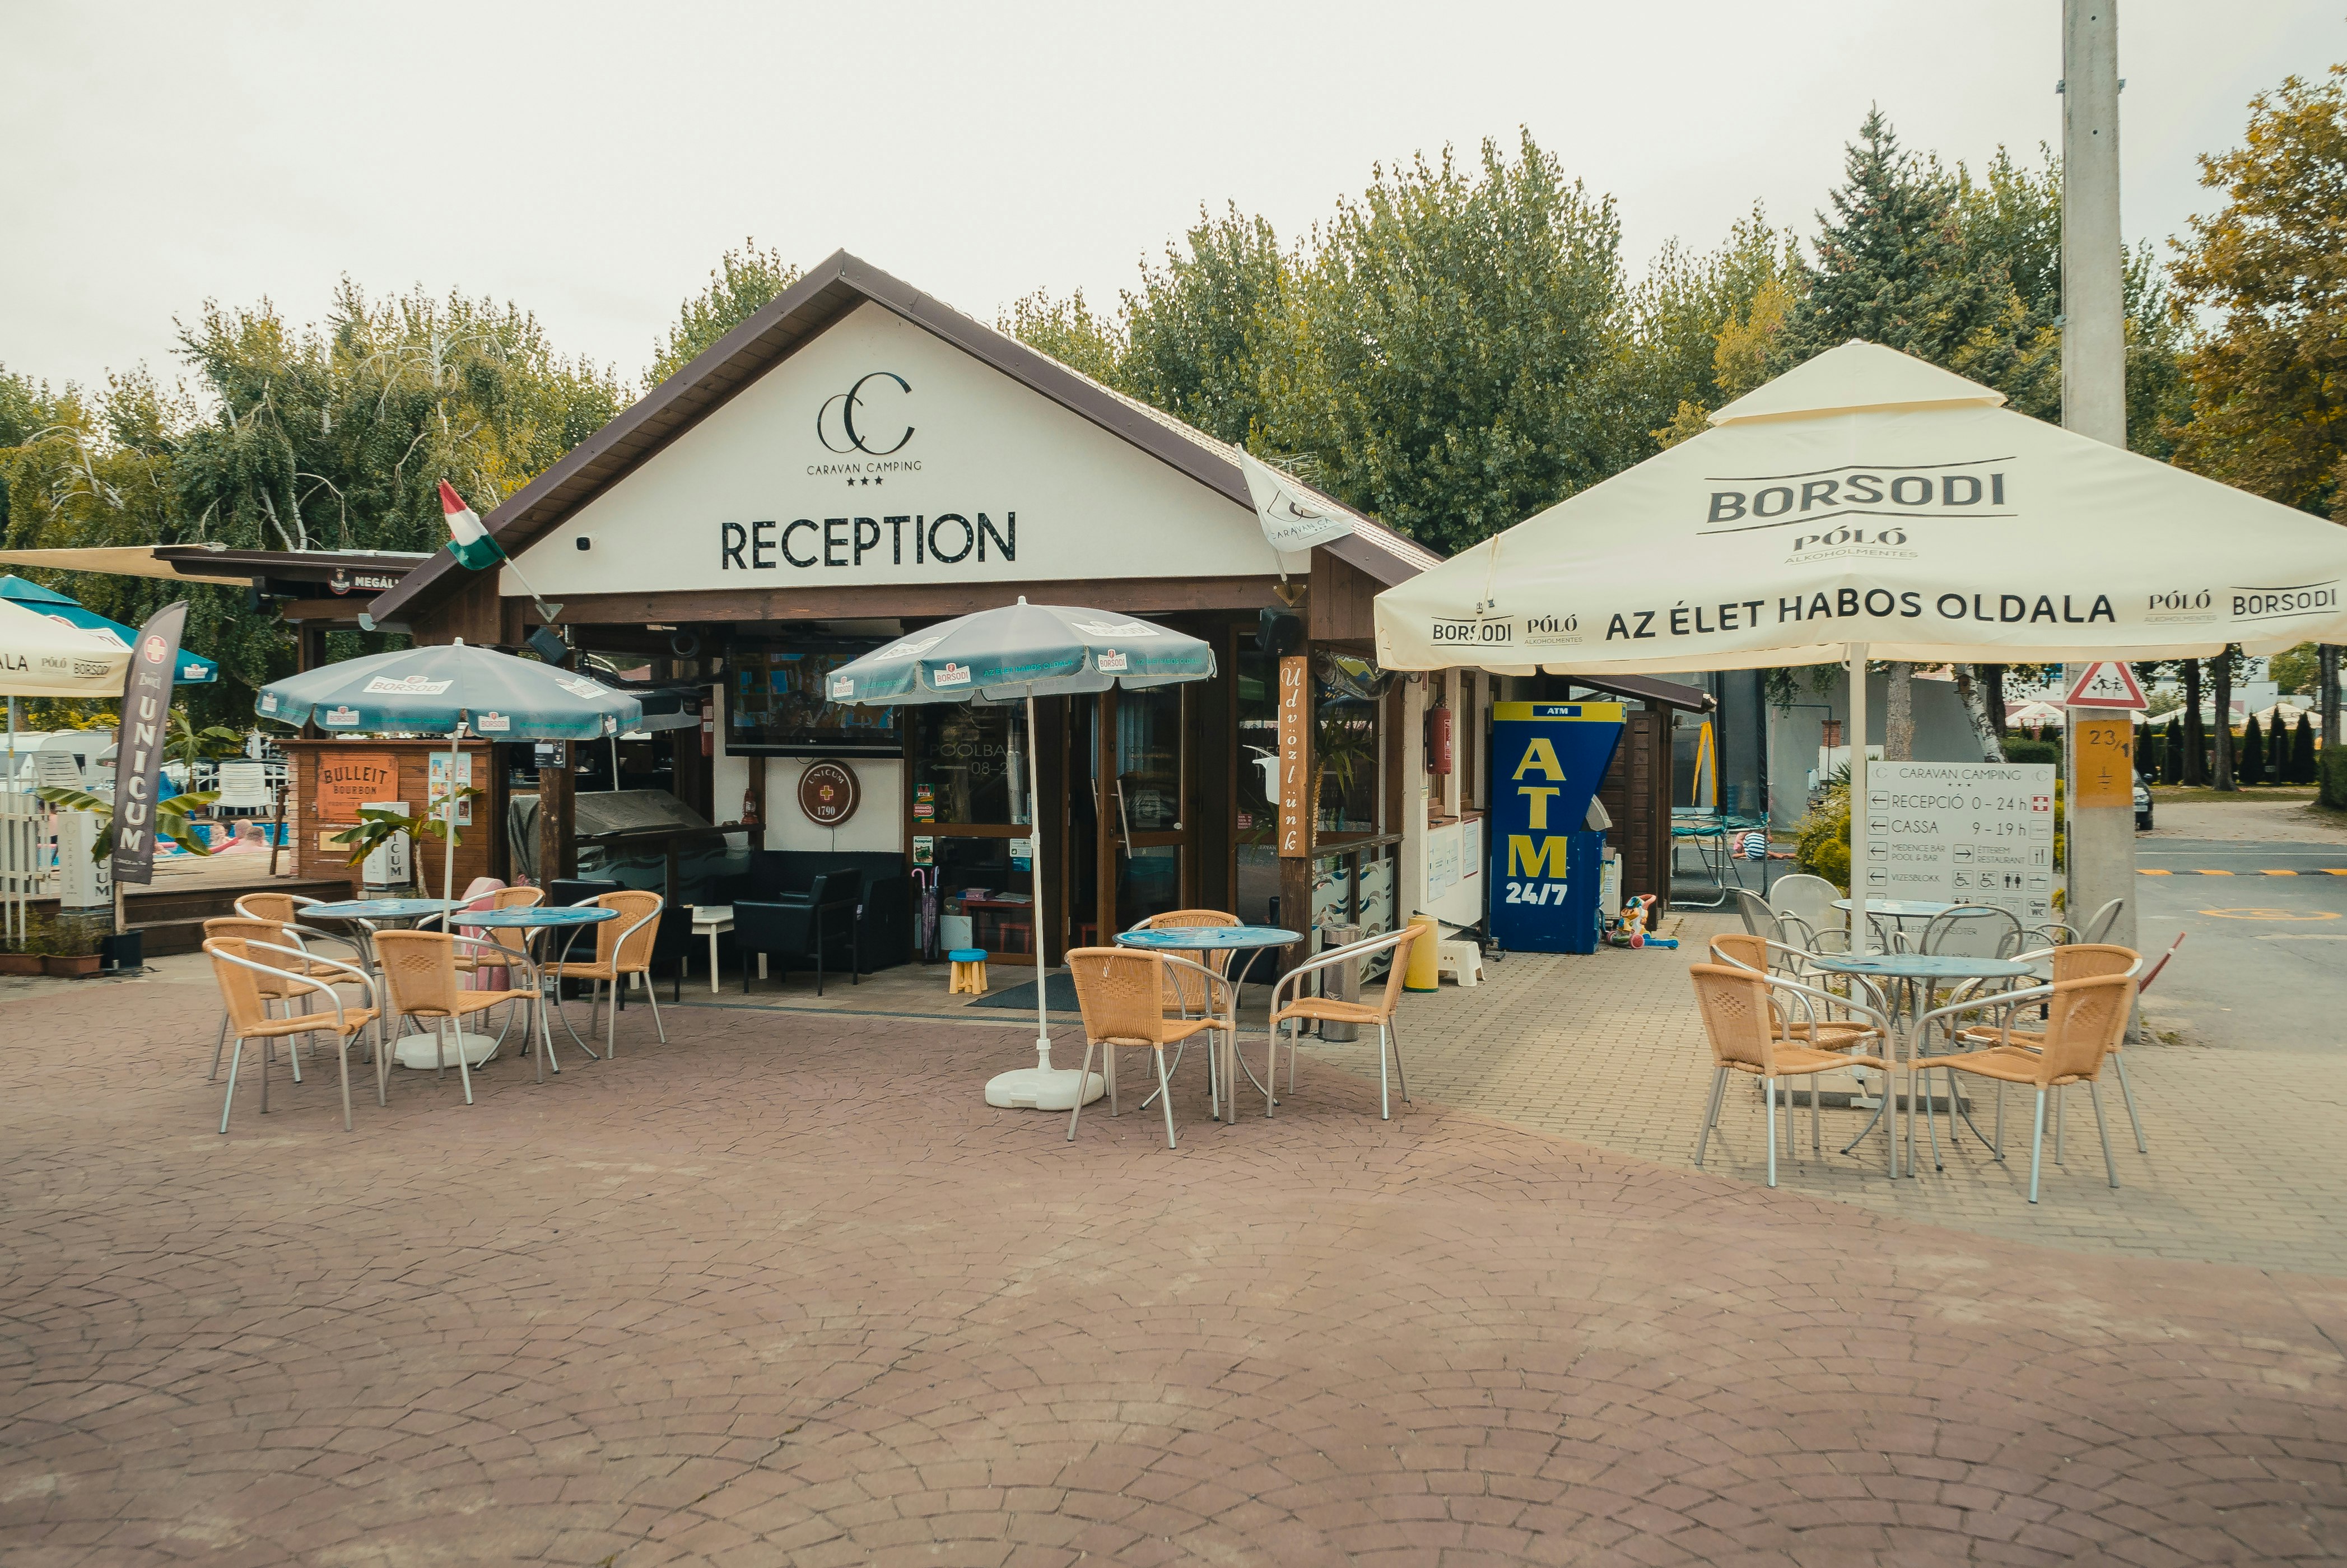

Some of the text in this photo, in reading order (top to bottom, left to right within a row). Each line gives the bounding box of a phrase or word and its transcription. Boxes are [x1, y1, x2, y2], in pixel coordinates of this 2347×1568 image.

[807, 460, 922, 475] CARAVAN CAMPING
[1707, 472, 2005, 524] BORSODI
[722, 511, 1016, 570] RECEPTION
[1793, 525, 1908, 552] PÓLÓ
[1784, 547, 1918, 565] ALKOHOLMENTES
[2149, 589, 2211, 609] PÓLÓ
[2233, 589, 2336, 616] BORSODI
[1605, 588, 2117, 640] AZ ÉLET HABOS OLDALA
[1528, 613, 1577, 634] PÓLÓ
[1524, 636, 1583, 645] ALKOHOLMENTES
[1016, 663, 1042, 673] HABOS
[1100, 658, 1125, 668] BORSODI
[937, 672, 968, 682] BORSODI
[370, 681, 441, 692] BORSODI
[1281, 661, 1302, 850] Üdvözlünk
[120, 696, 158, 852] UNICUM
[324, 765, 388, 785] BULLEIT
[808, 770, 844, 784] UNICUM
[1899, 768, 2022, 780] CARAVAN CAMPING
[333, 785, 377, 794] BOURBON
[818, 806, 836, 815] 1790
[1507, 738, 1568, 878] ATM
[1892, 793, 1964, 809] RECEPCIÓ
[1972, 797, 1981, 809] 0
[1996, 797, 2014, 810] 24
[2019, 798, 2027, 811] h
[1892, 820, 1939, 834] CASSA
[1972, 822, 1980, 835] 9
[1996, 822, 2014, 836] 19
[2018, 823, 2026, 836] h
[1931, 843, 1945, 852] BÁR
[95, 819, 110, 897] UCUM
[1891, 874, 1940, 882] VIZESBLOKK
[1506, 882, 1568, 905] 24/7
